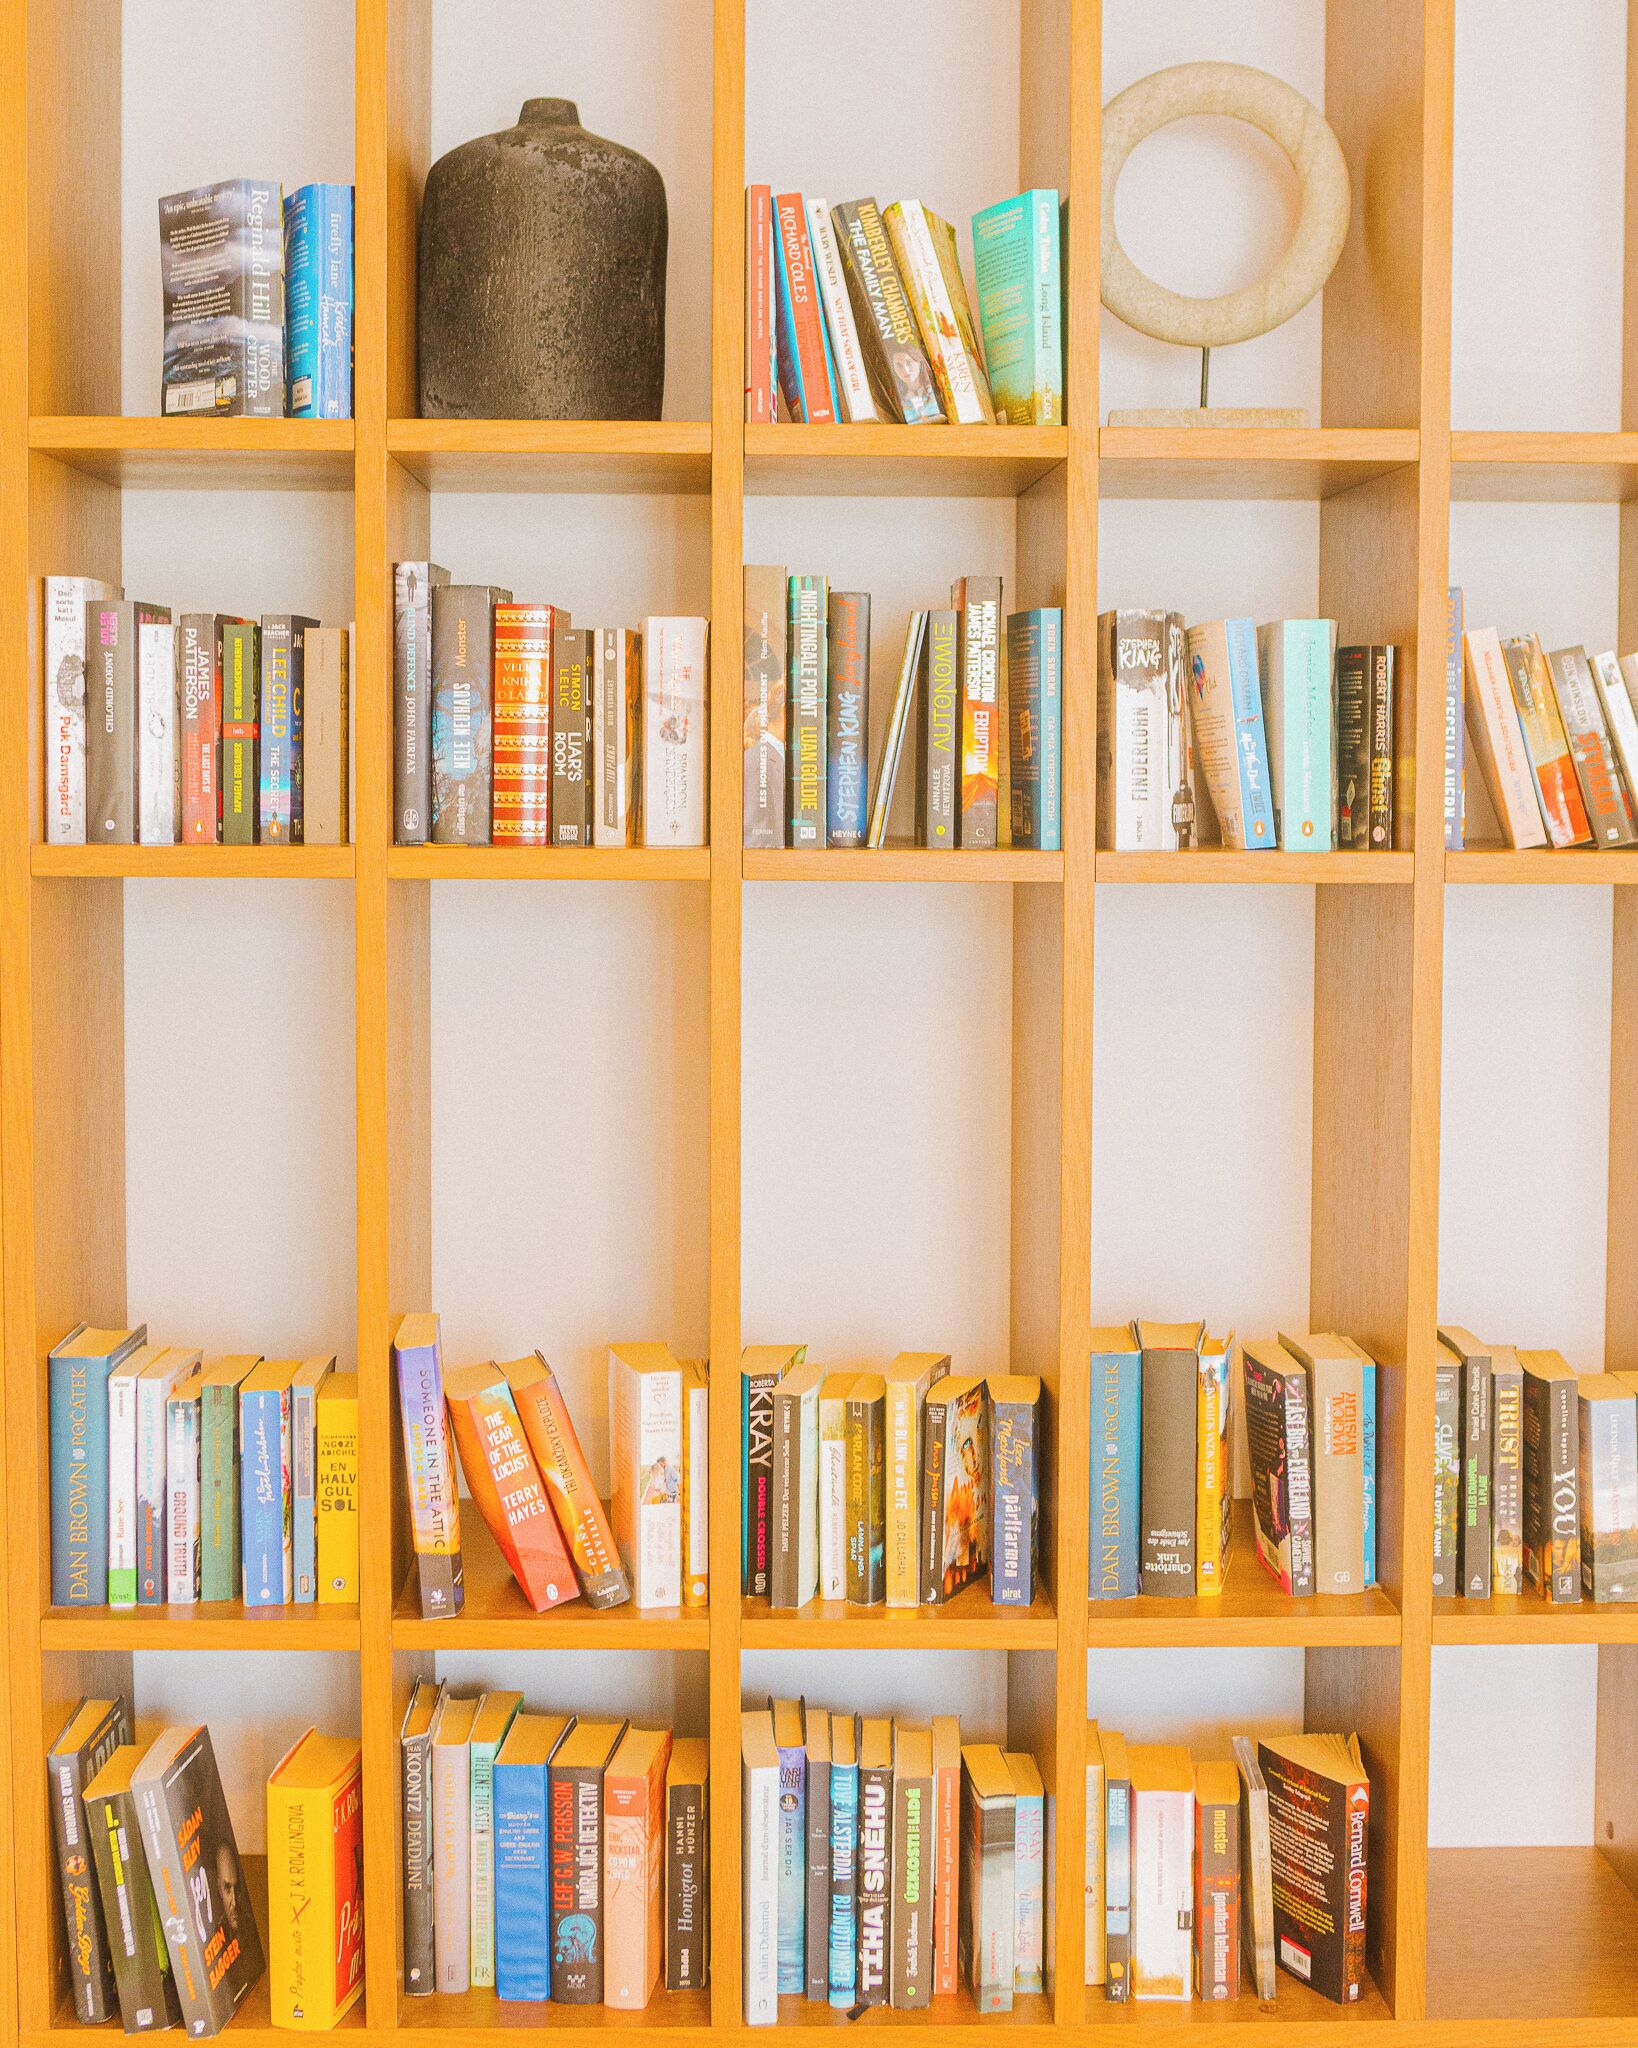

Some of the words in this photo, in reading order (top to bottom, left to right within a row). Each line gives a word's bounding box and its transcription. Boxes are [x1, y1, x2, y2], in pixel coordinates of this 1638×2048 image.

[247, 189, 270, 277] Reginald
[329, 213, 341, 258] firefly
[781, 206, 801, 262] RICHARD
[820, 227, 829, 250] MARY
[849, 220, 867, 248] THE
[330, 259, 340, 288] lane
[790, 264, 808, 304] COLES
[823, 251, 838, 287] WESLEY
[857, 249, 881, 300] FAMILY
[858, 203, 890, 274] KIMBERLEY
[880, 275, 915, 345] CHAMBERS
[252, 281, 271, 321] Hill
[833, 298, 842, 313] NOT
[872, 300, 895, 340] MAN
[247, 335, 258, 399] CUTTER
[259, 344, 270, 392] WOOD
[57, 590, 72, 598] Den
[407, 608, 416, 639] BLIND
[456, 618, 467, 668] Monster
[801, 589, 817, 671] NIGHTINGALE
[967, 602, 981, 639] JAMES
[982, 600, 996, 647] MICHAEL
[1047, 624, 1055, 652] ROBIN
[272, 647, 287, 681] LEE
[407, 641, 416, 692] DEFENCE
[1119, 638, 1160, 651] STEPHEN
[1119, 650, 1162, 669] KING
[1563, 656, 1575, 677] DON
[104, 651, 114, 692] SODNÝ
[185, 628, 197, 720] PATTERSON
[197, 647, 210, 700] JAMES
[559, 668, 570, 707] LELIC
[571, 664, 581, 711] SIMON
[967, 641, 981, 701] PATTERSON
[982, 650, 995, 702] CRICHTON
[1377, 655, 1386, 700] ROBERT
[105, 694, 114, 733] CHLORID
[272, 683, 287, 737] CHILD
[407, 695, 416, 728] JOHN
[453, 682, 470, 731] NEUHAUS
[801, 672, 817, 718] POINT
[1568, 679, 1589, 726] WINSLOW
[59, 716, 72, 743] Puk
[801, 726, 817, 763] LUAN
[974, 710, 989, 773] ERUPTION
[1376, 704, 1386, 751] HARRIS
[271, 745, 279, 767] THE
[406, 730, 416, 775] FAIRFAX
[453, 733, 470, 770] NELE
[554, 731, 566, 776] ROOM
[567, 732, 582, 782] LIAR'S
[1132, 707, 1148, 801] FINDERLOHN
[1577, 732, 1616, 815] STYRKAN
[60, 745, 72, 816] Damsgård
[270, 770, 279, 810] SECRET
[801, 764, 817, 811] GOLDIE
[750, 1379, 775, 1388] ROBERTA
[1104, 1363, 1119, 1441] POČÁTEK
[1471, 1366, 1480, 1415] Cohn-Bendit
[420, 1369, 437, 1446] SOMEONE
[484, 1411, 504, 1429] THE
[750, 1389, 773, 1468] KRAY
[1284, 1398, 1306, 1428] LAST
[1332, 1392, 1345, 1456] MAGICAL
[1345, 1392, 1357, 1456] MYSTERY
[1471, 1416, 1480, 1441] Daniel
[1499, 1384, 1519, 1468] TRUST
[324, 1440, 354, 1448] NGOZI
[487, 1427, 512, 1446] YEAR
[489, 1447, 503, 1466] OF
[503, 1440, 523, 1458] THE
[1287, 1428, 1308, 1450] BUS
[1439, 1424, 1453, 1465] CLIVE
[320, 1474, 357, 1484] HALV
[330, 1463, 347, 1471] EN
[428, 1451, 439, 1469] IN
[493, 1456, 530, 1482] LOCUST
[70, 1462, 88, 1543] BROWN
[321, 1499, 357, 1512] SOL
[325, 1487, 353, 1497] GUL
[430, 1473, 442, 1503] THE
[503, 1483, 540, 1510] TERRY
[757, 1476, 766, 1518] DOUBLE
[1103, 1458, 1121, 1537] BROWN
[1287, 1459, 1311, 1519] EVERLAND
[1552, 1467, 1576, 1535] YOU
[174, 1491, 187, 1541] GROUND
[431, 1509, 446, 1548] ATTIC
[508, 1499, 546, 1526] HAYES
[577, 1523, 597, 1566] CHINA
[757, 1520, 766, 1569] CROSSED
[1004, 1493, 1022, 1578] pärlfarmen
[1157, 1552, 1180, 1564] Link
[70, 1551, 88, 1599] DAN
[174, 1542, 187, 1577] TRUTH
[1102, 1545, 1120, 1592] DAN
[1145, 1562, 1191, 1574] Charlotte
[1002, 1588, 1022, 1600] pirat
[407, 1753, 422, 1812] KOONTZ
[475, 1757, 489, 1790] HELENE
[177, 1807, 204, 1848] SÅDAN
[475, 1793, 489, 1835] TURSTEN
[554, 1781, 574, 1842] PERSSON
[579, 1782, 598, 1843] DETEKTIV
[906, 1788, 920, 1825] LIDÉ
[1109, 1788, 1117, 1826] NESSER
[1117, 1788, 1126, 1826] HÅKAN
[687, 1805, 695, 1855] MÜNZER
[862, 1784, 887, 1892] SNĚHU
[1017, 1809, 1026, 1861] WIGGS
[1030, 1809, 1040, 1860] SUSAN
[1214, 1809, 1226, 1855] monster
[1350, 1811, 1366, 1866] Bernard
[182, 1835, 202, 1873] BLEV
[407, 1820, 422, 1891] DEADLINE
[554, 1846, 574, 1863] W.
[554, 1865, 574, 1879] G.
[904, 1832, 920, 1904] ÚZKOSTI
[554, 1883, 574, 1909] LEIF
[578, 1844, 598, 1910] UMÍRAJÍCÍ
[677, 1862, 698, 1932] Honigtot
[1211, 1891, 1230, 1933] jonathan
[1349, 1869, 1366, 1934] Cornwell
[204, 1926, 226, 1969] STEIN
[759, 1901, 770, 1949] Duhamel
[209, 1938, 241, 1991] BAGGER
[759, 1952, 770, 1983] Alain
[861, 1904, 884, 1993] TÍHA
[1213, 1934, 1229, 1983] kellerman
